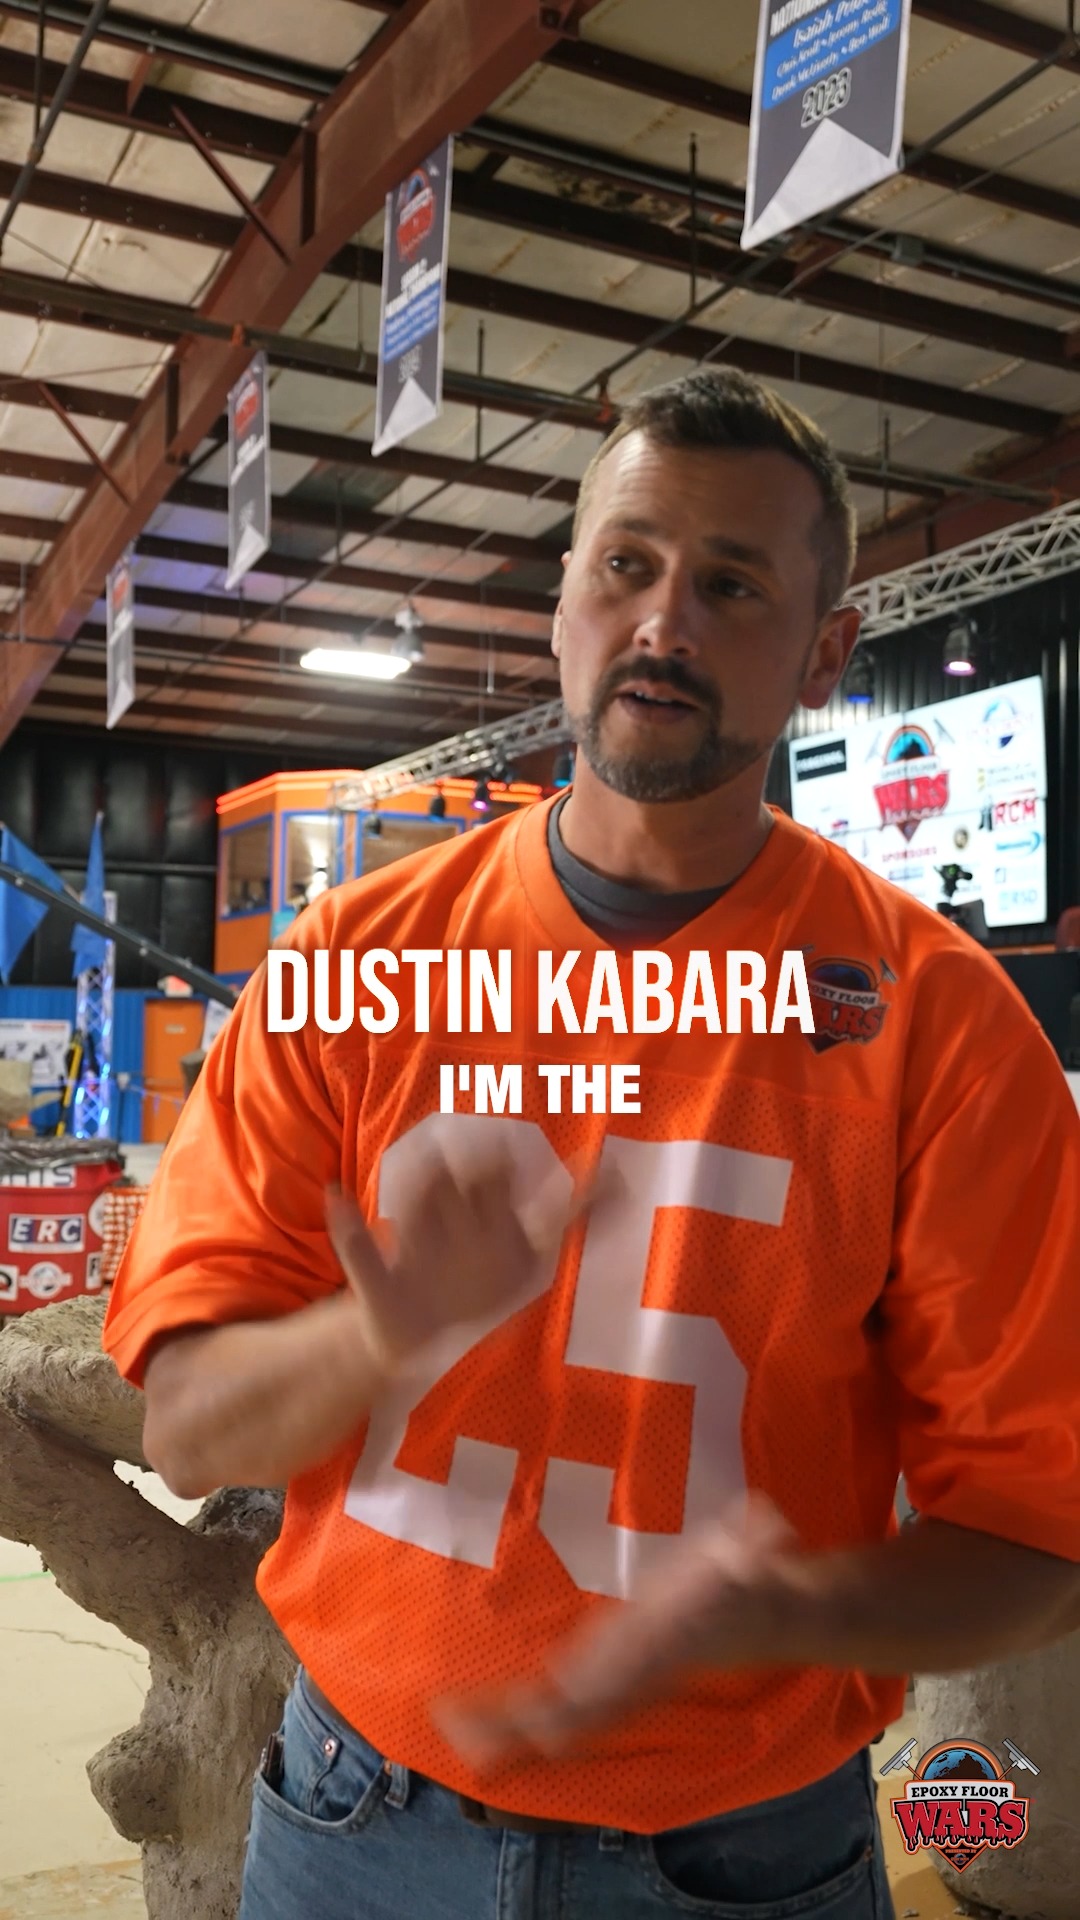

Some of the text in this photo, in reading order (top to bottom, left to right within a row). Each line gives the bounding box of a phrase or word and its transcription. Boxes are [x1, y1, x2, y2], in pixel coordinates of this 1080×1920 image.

[770, 0, 828, 37] NATION
[801, 67, 852, 128] 2023
[873, 771, 949, 823] WARS
[995, 798, 1037, 826] RCM
[838, 992, 877, 1004] FLOOR
[814, 1002, 887, 1040] ARS
[12, 1218, 81, 1243] ERC
[343, 1111, 793, 1600] 25
